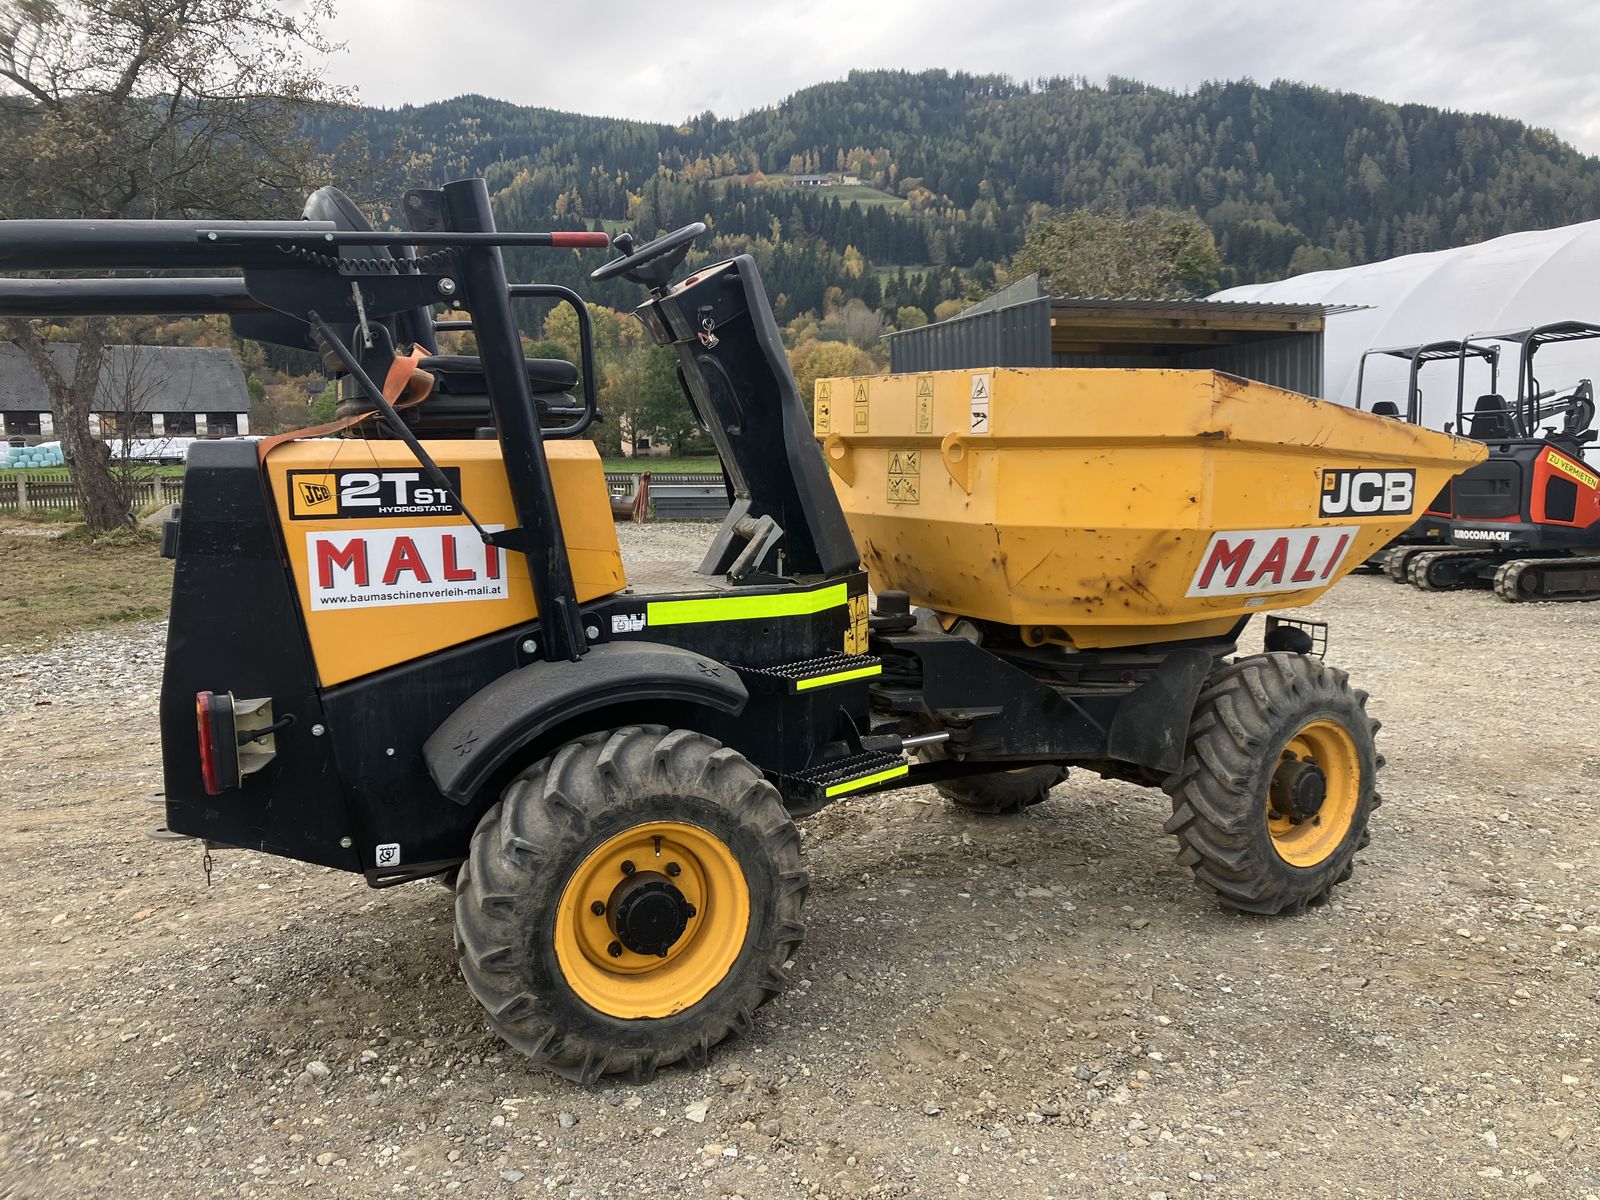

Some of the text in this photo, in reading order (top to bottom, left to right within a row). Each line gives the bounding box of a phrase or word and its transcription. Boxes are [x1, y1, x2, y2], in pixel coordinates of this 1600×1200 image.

[1549, 453, 1597, 487] ZU VERMIETEN
[303, 484, 331, 505] JCB
[378, 504, 453, 514] HYDROSTATIC
[1322, 472, 1413, 514] JCB
[316, 534, 500, 588] MALI
[1197, 533, 1350, 589] MALI
[320, 585, 502, 605] www.baumaschinenverleih-mali.at
